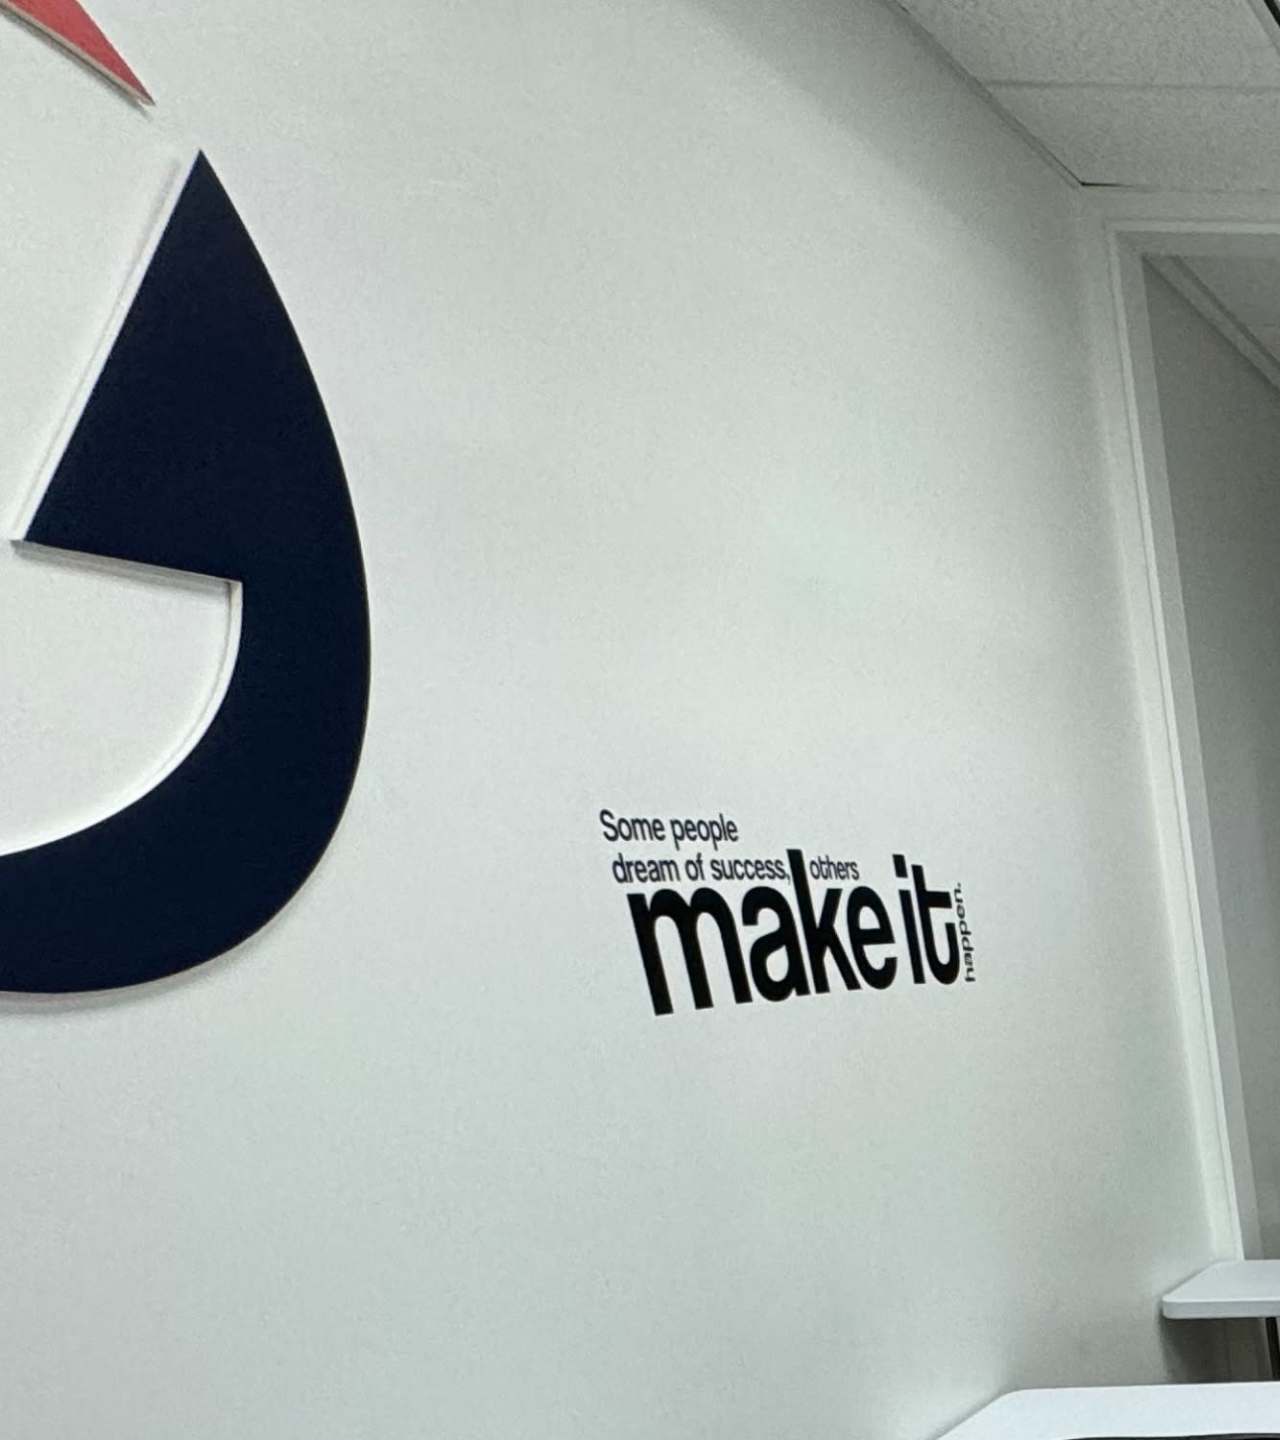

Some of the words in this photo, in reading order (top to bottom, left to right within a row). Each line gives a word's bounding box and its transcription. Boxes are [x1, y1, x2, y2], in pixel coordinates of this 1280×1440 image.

[600, 809, 666, 842] Some
[670, 813, 739, 851] people
[612, 853, 681, 883] dream
[685, 852, 708, 881] of
[711, 857, 791, 885] success,
[809, 856, 860, 882] others
[626, 848, 898, 1016] make
[892, 853, 961, 985] it
